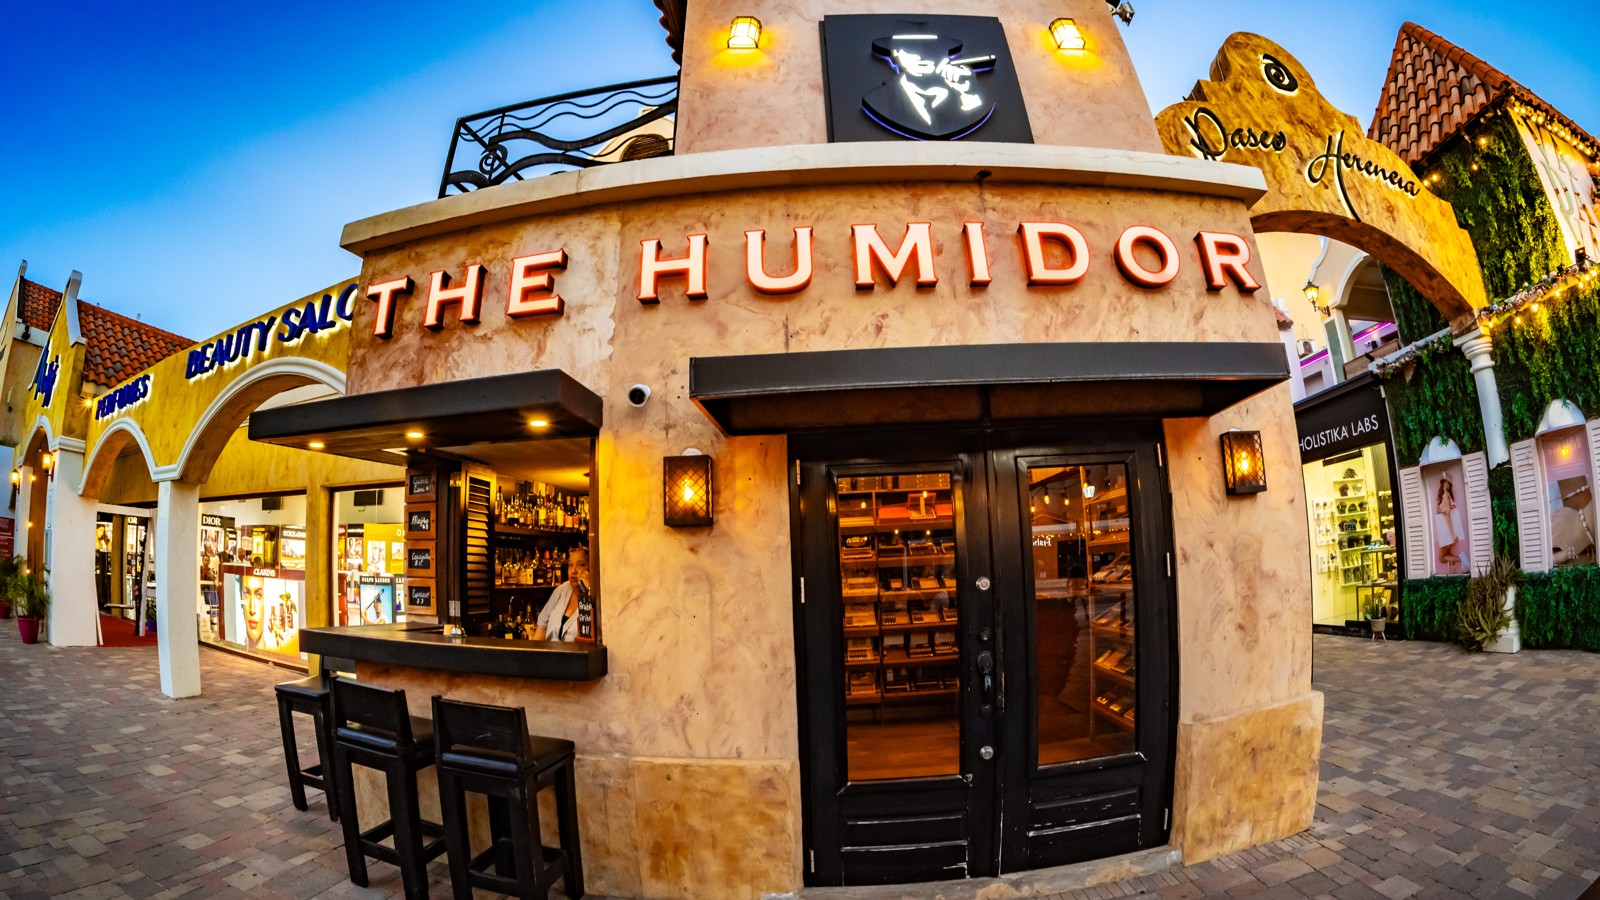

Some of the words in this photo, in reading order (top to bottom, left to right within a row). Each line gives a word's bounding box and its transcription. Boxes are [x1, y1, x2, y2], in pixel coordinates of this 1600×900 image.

[1184, 107, 1287, 161] Paseo
[1308, 129, 1421, 222] Herencia
[366, 248, 568, 339] THE
[636, 221, 1262, 304] HUMIDOR
[185, 316, 277, 380] BEAUTY
[1351, 414, 1379, 437] LABS
[202, 515, 221, 526] DIOR
[253, 568, 276, 577] CLARINS
